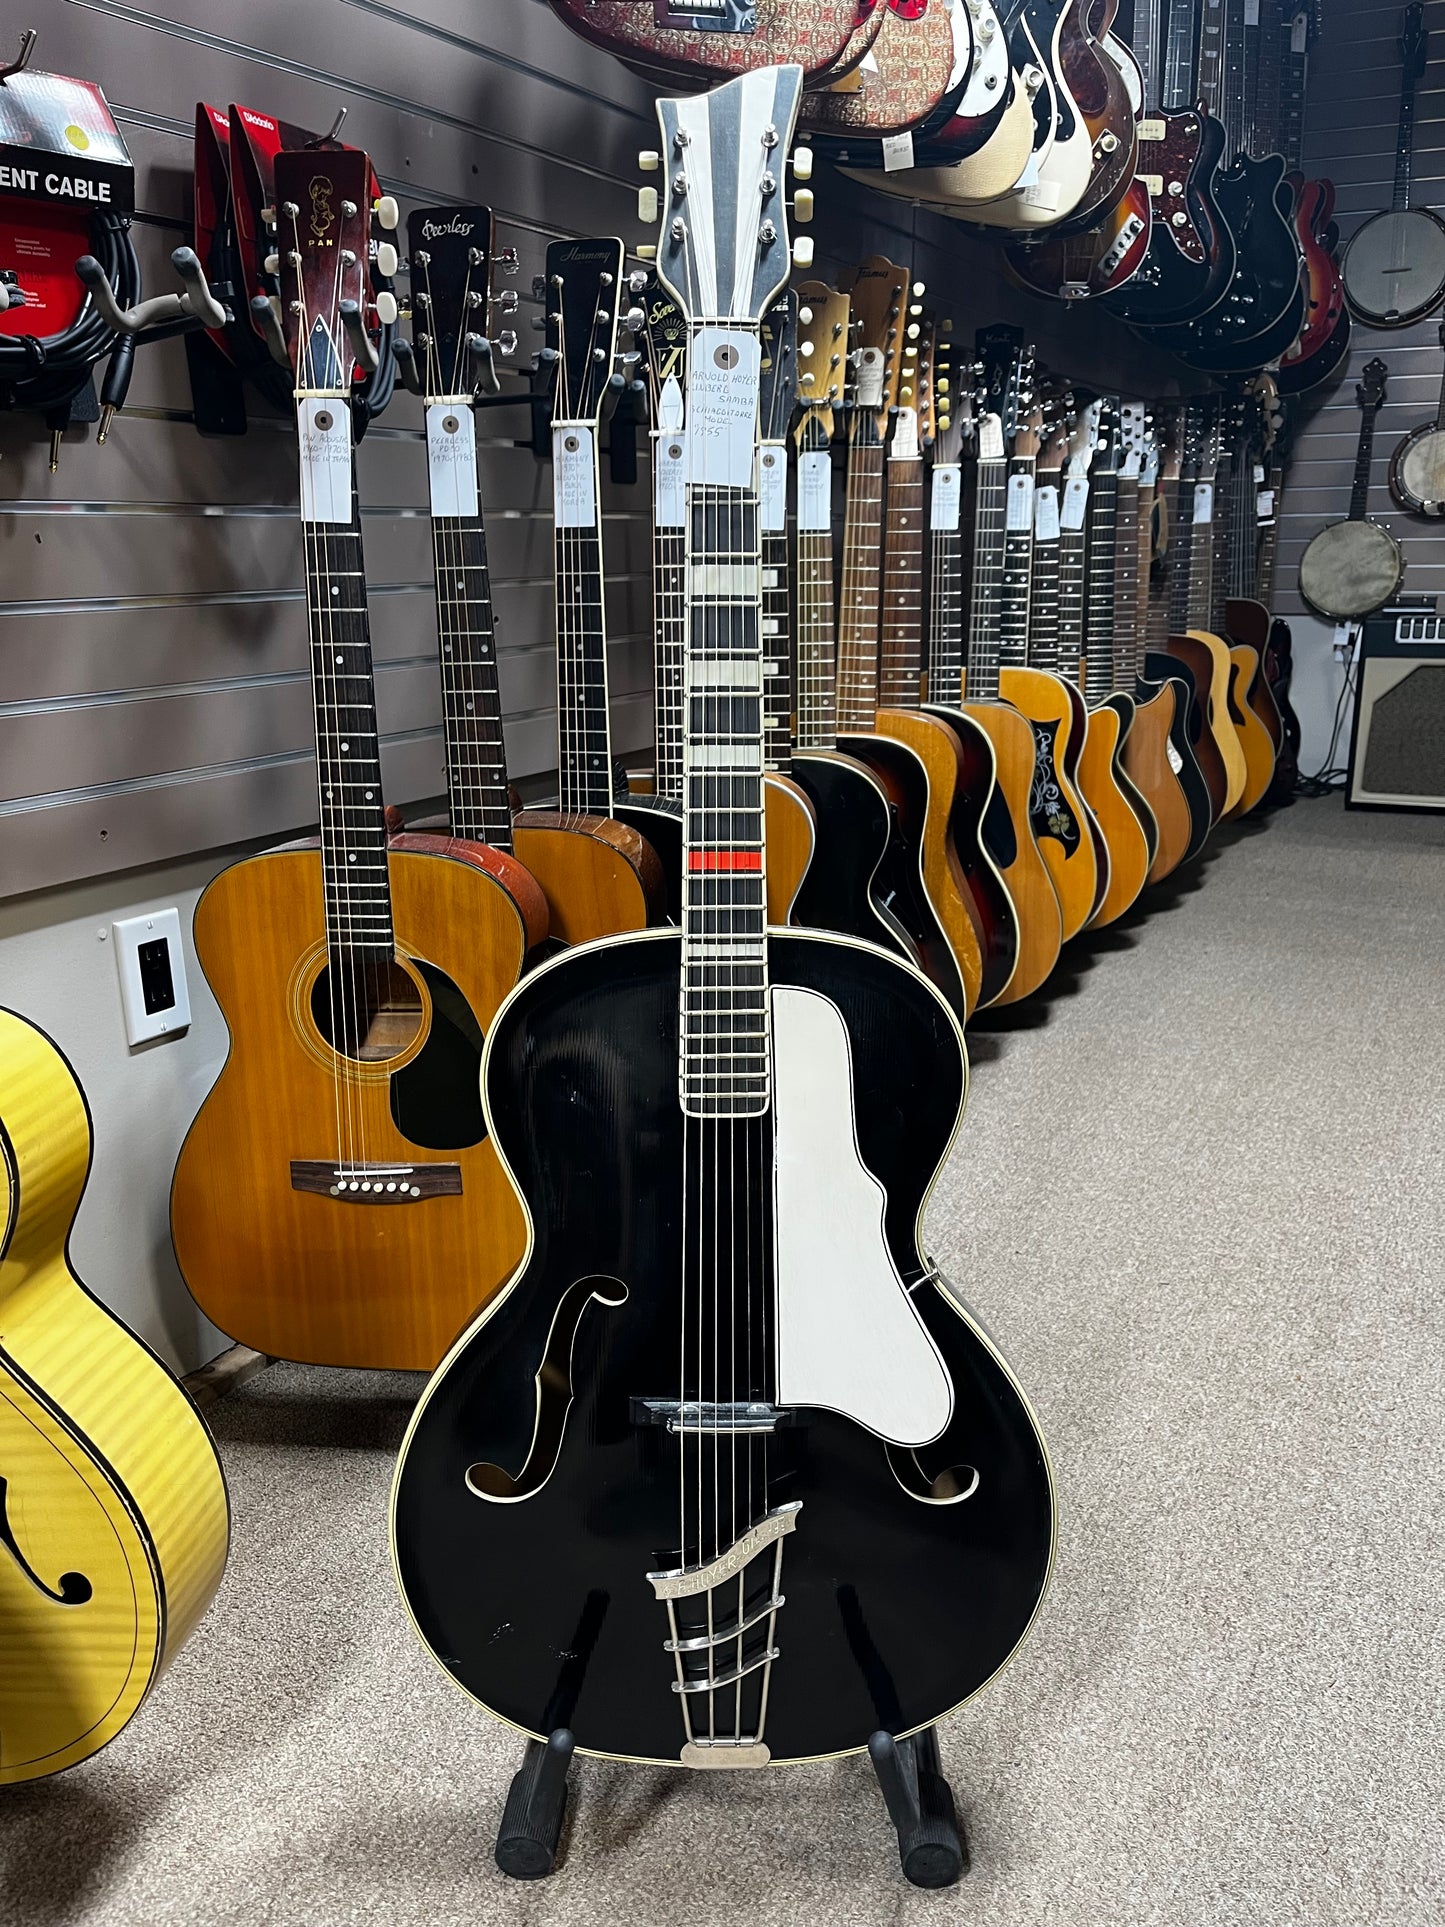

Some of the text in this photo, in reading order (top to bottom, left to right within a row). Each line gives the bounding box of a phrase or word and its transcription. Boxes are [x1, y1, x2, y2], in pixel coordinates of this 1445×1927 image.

[45, 173, 111, 203] CABLE
[421, 213, 475, 241] Peerless
[308, 239, 333, 247] PAN
[559, 246, 611, 264] Harmony
[717, 395, 754, 407] SAMBA
